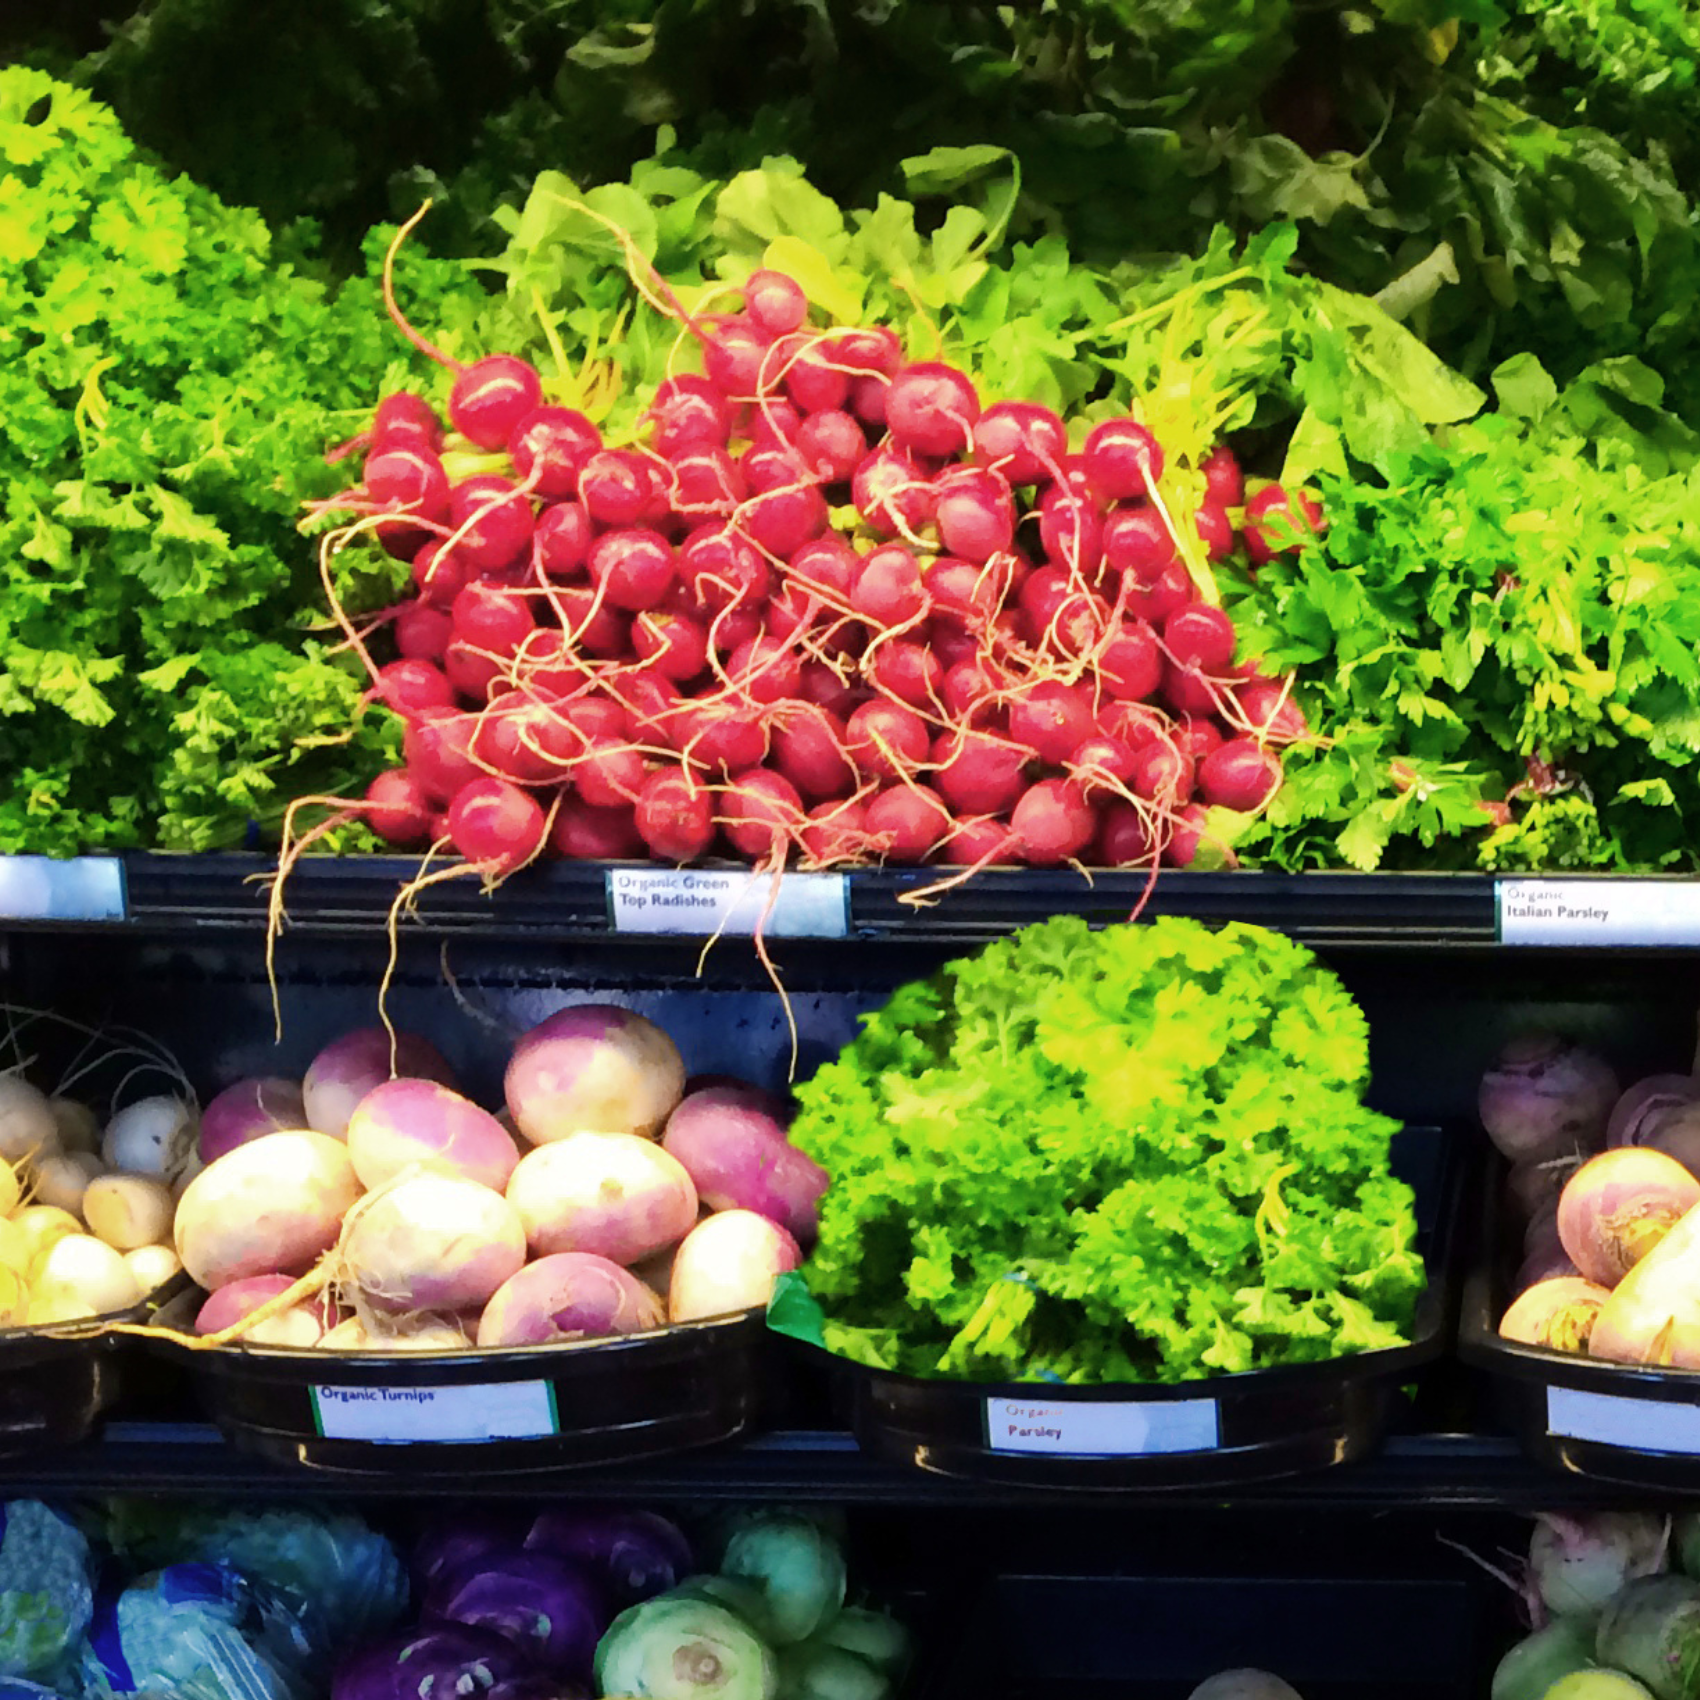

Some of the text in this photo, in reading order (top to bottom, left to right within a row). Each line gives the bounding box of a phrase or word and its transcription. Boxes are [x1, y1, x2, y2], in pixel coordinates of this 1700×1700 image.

[618, 876, 730, 891] Organic Green
[619, 893, 717, 909] Top Radishes
[1507, 905, 1609, 922] Italian Parsley
[321, 1386, 435, 1404] Organic Turnips
[1008, 1425, 1062, 1440] Parsley
